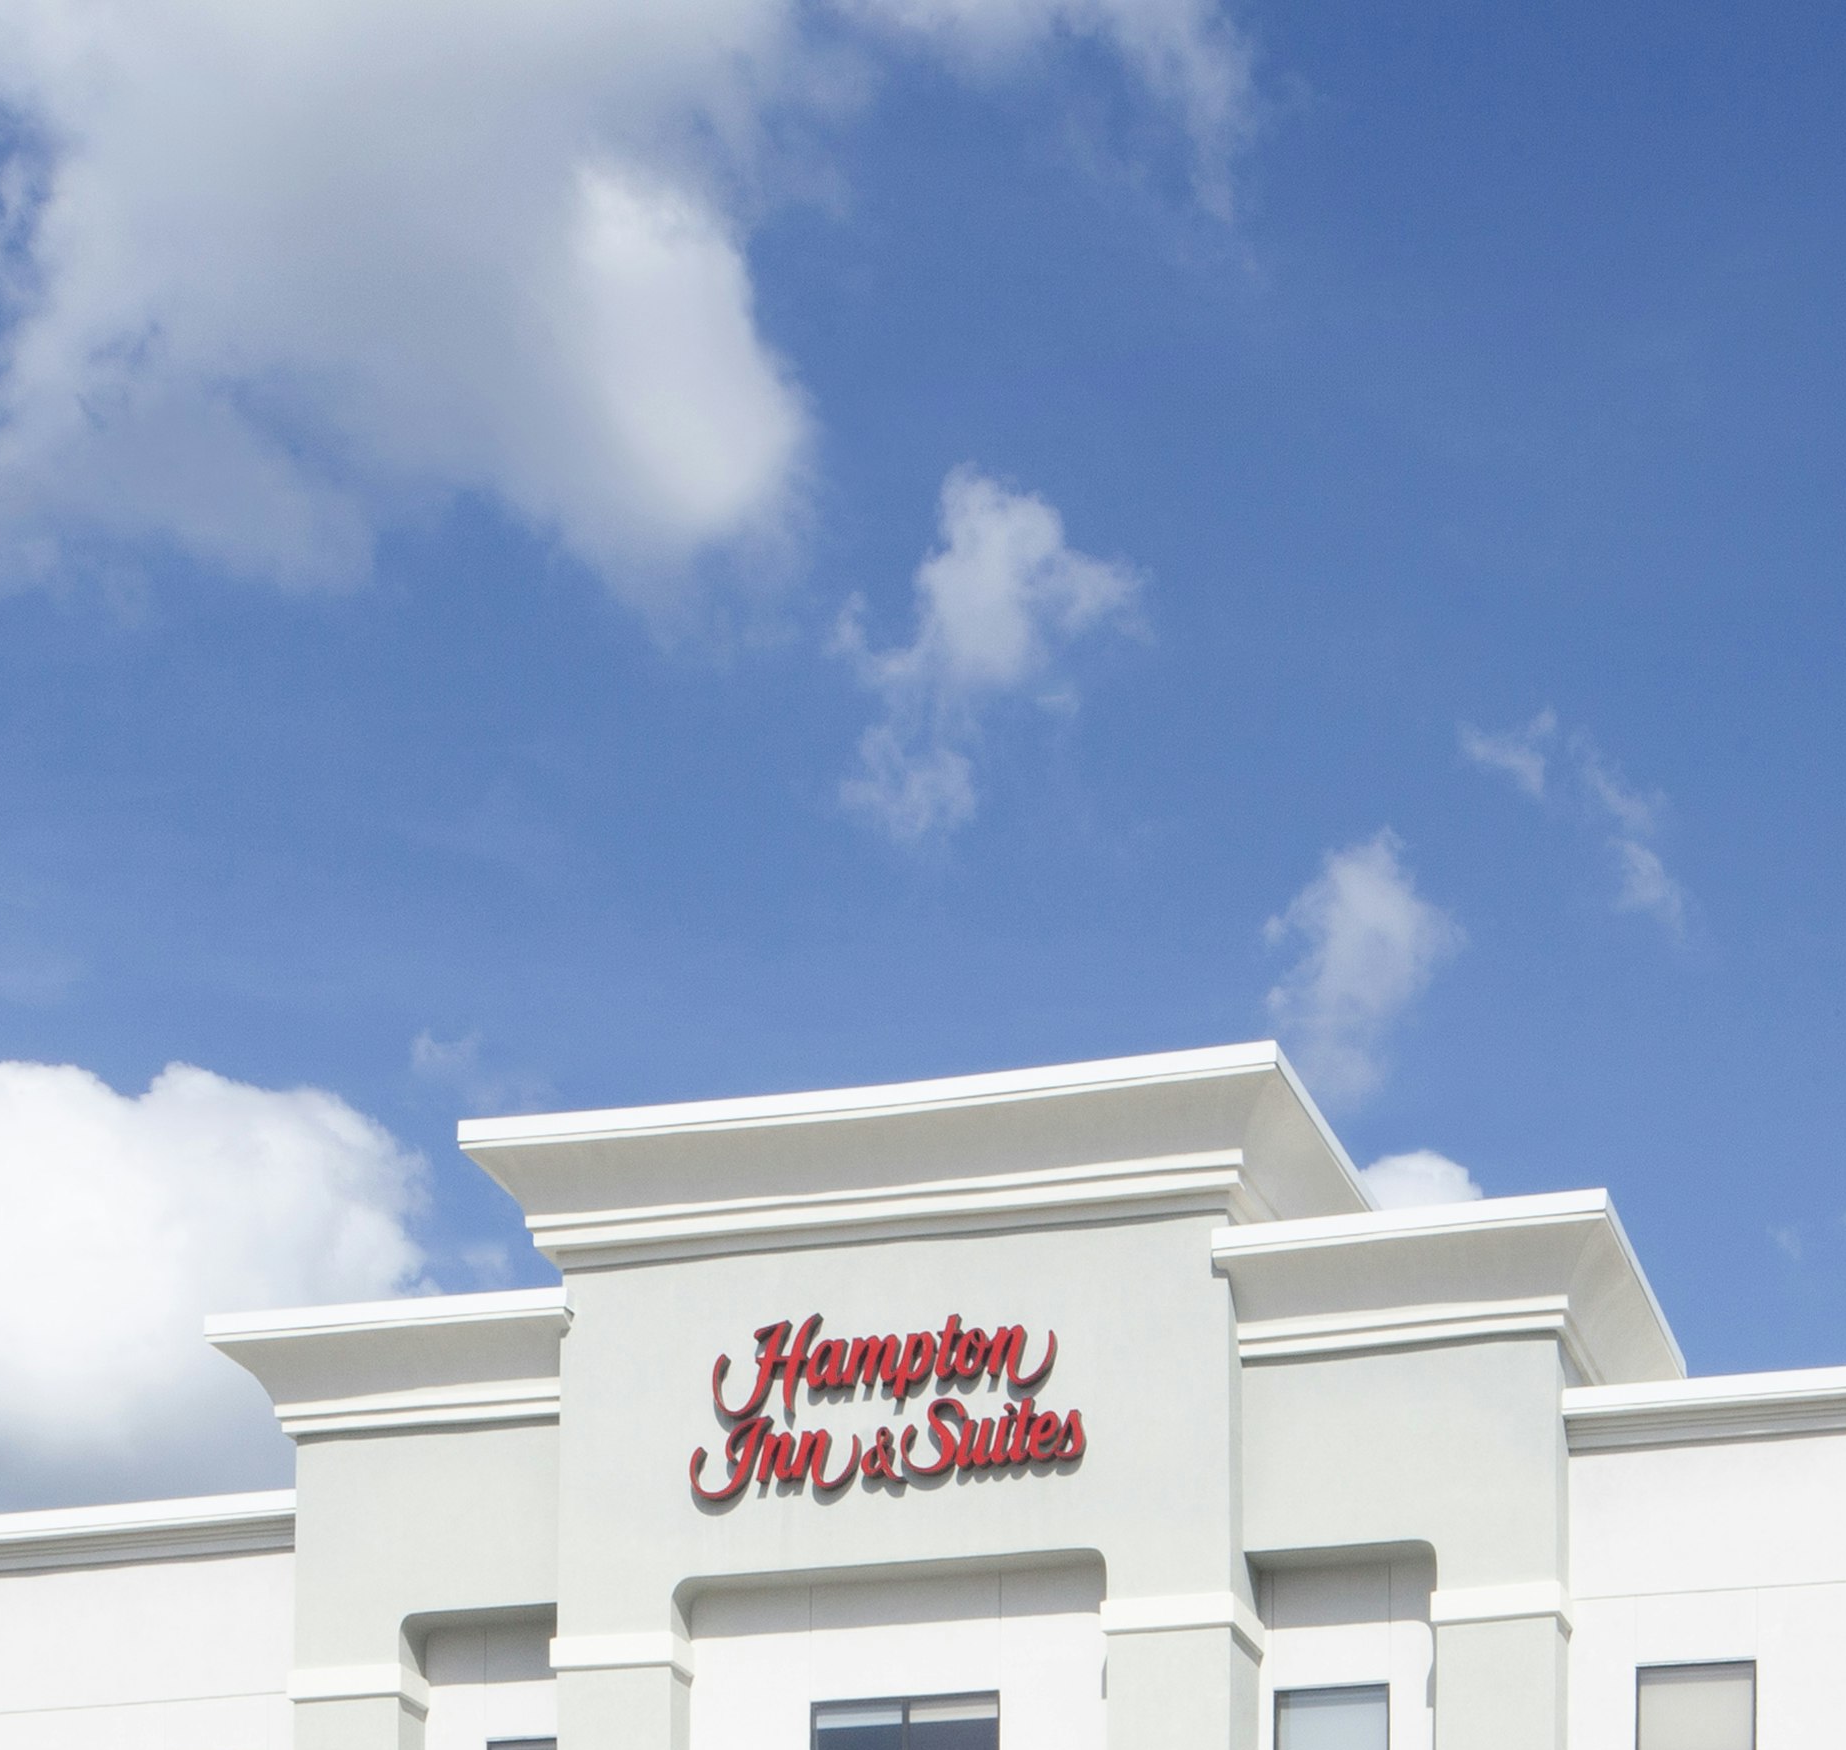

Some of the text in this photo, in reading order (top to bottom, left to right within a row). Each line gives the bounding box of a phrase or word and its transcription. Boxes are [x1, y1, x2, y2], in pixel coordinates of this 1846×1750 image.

[712, 1313, 1058, 1418] Hampton
[690, 1397, 1086, 1500] Inn & Suites
